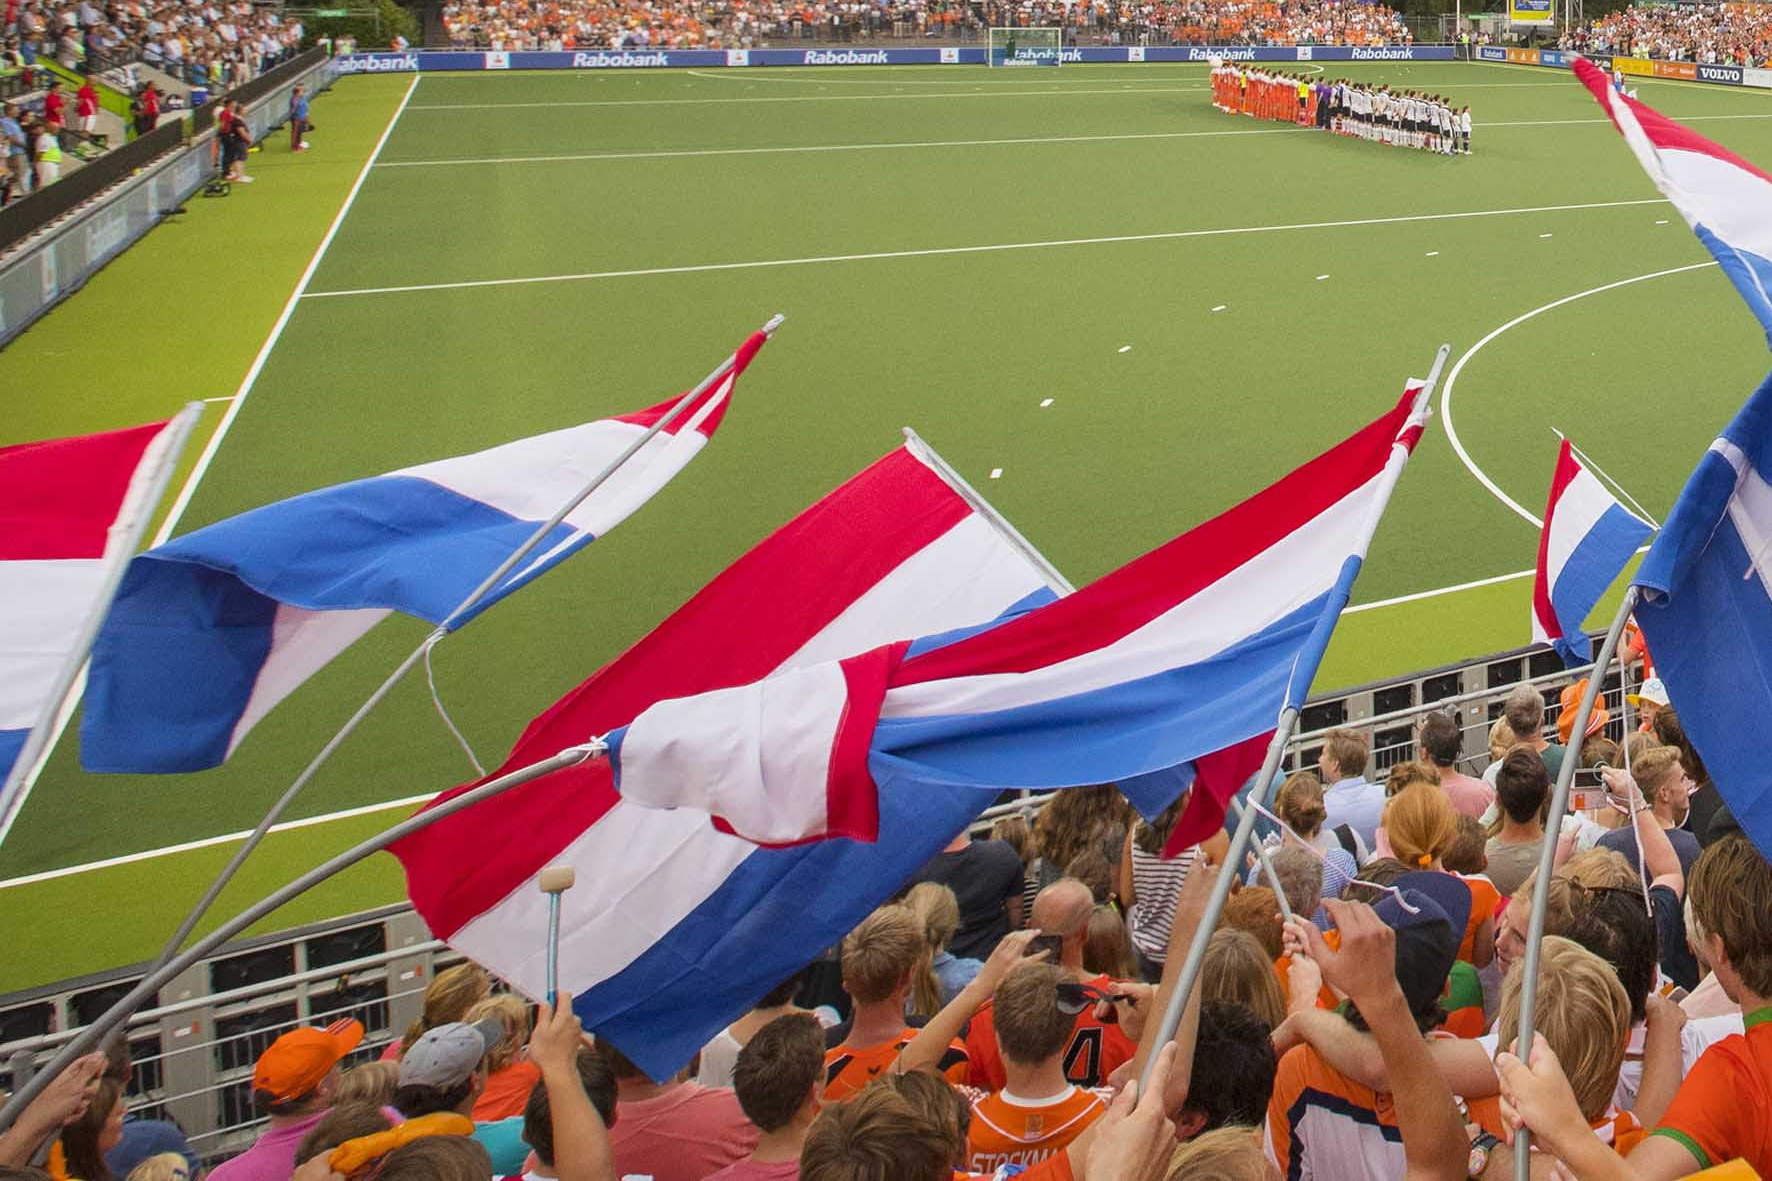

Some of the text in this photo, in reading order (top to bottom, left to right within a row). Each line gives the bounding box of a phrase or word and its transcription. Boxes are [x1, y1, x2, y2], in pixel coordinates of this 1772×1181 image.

[573, 52, 668, 67] Rabobank
[803, 50, 888, 64] Rabobank
[1188, 47, 1256, 60] Rabobank
[1352, 47, 1413, 60] Rabobank
[339, 53, 418, 71] abobank
[1700, 68, 1740, 81] VOLVO
